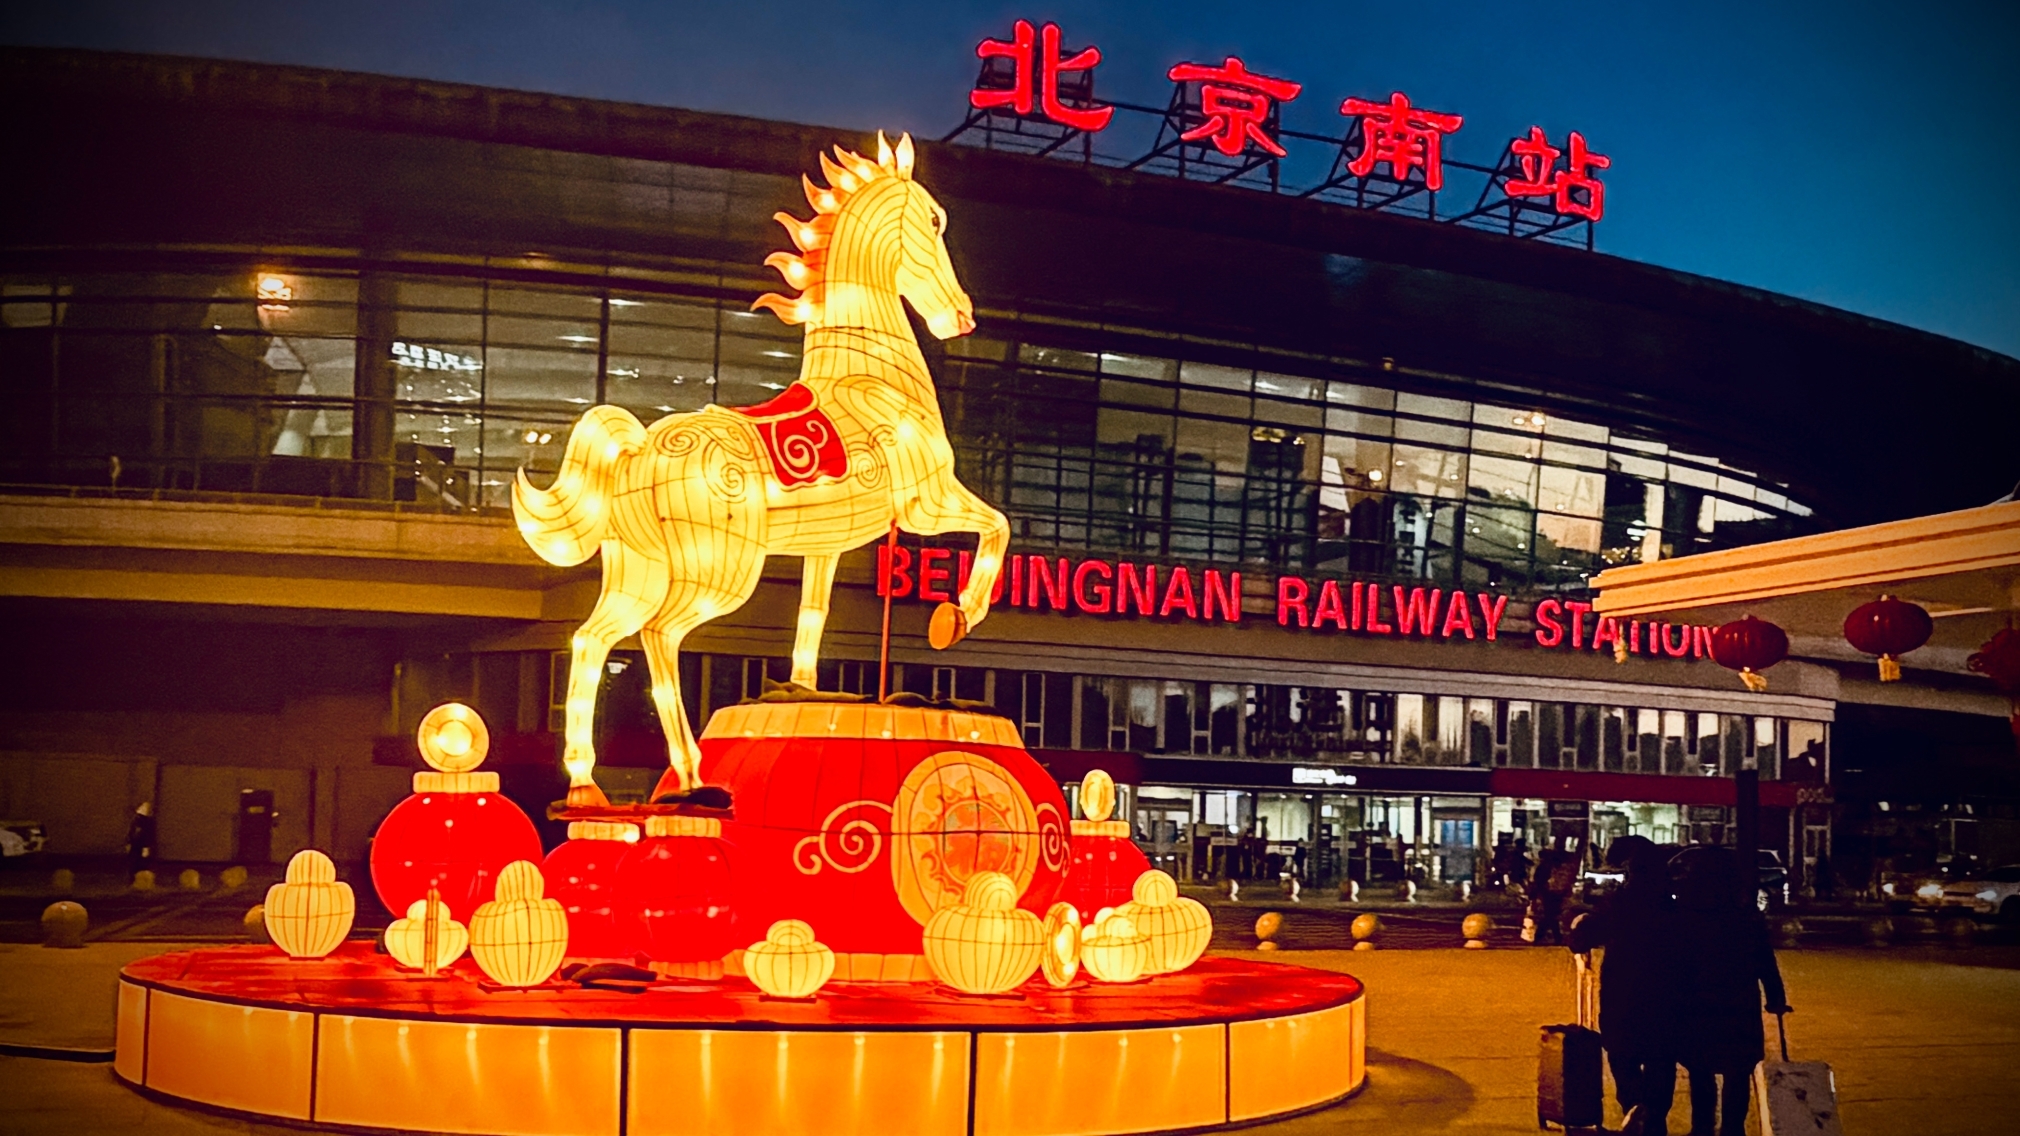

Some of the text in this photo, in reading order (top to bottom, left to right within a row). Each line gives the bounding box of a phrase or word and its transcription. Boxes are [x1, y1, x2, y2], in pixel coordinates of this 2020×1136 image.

[969, 19, 1611, 222] 北京南站
[1277, 576, 1509, 642] RAILWAY
